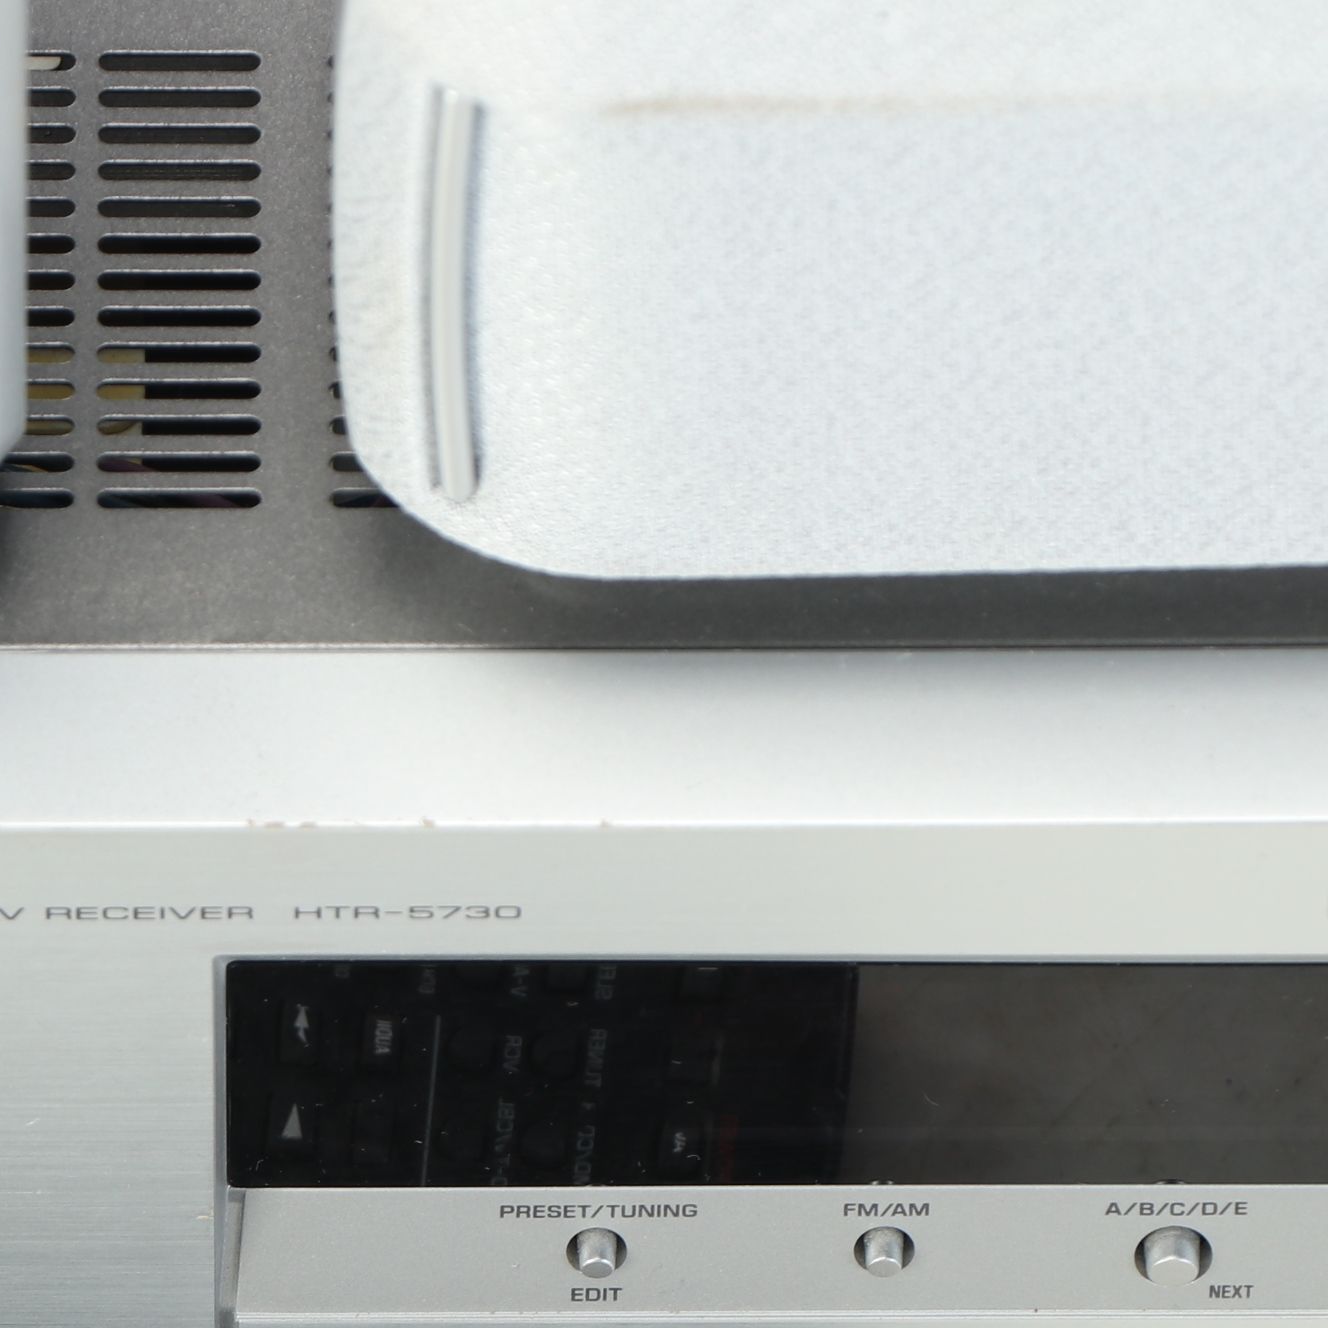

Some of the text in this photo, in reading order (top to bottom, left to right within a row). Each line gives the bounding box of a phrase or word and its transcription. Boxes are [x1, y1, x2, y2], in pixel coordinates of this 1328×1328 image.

[46, 906, 254, 920] RECEIVER
[294, 905, 522, 920] HTR-5730
[499, 1204, 698, 1219] PRESET/TUNING
[843, 1202, 930, 1217] FM/AM
[1105, 1201, 1248, 1217] A/B/C/D/E
[571, 1287, 622, 1302] EDIT
[1209, 1284, 1253, 1299] NEXT
